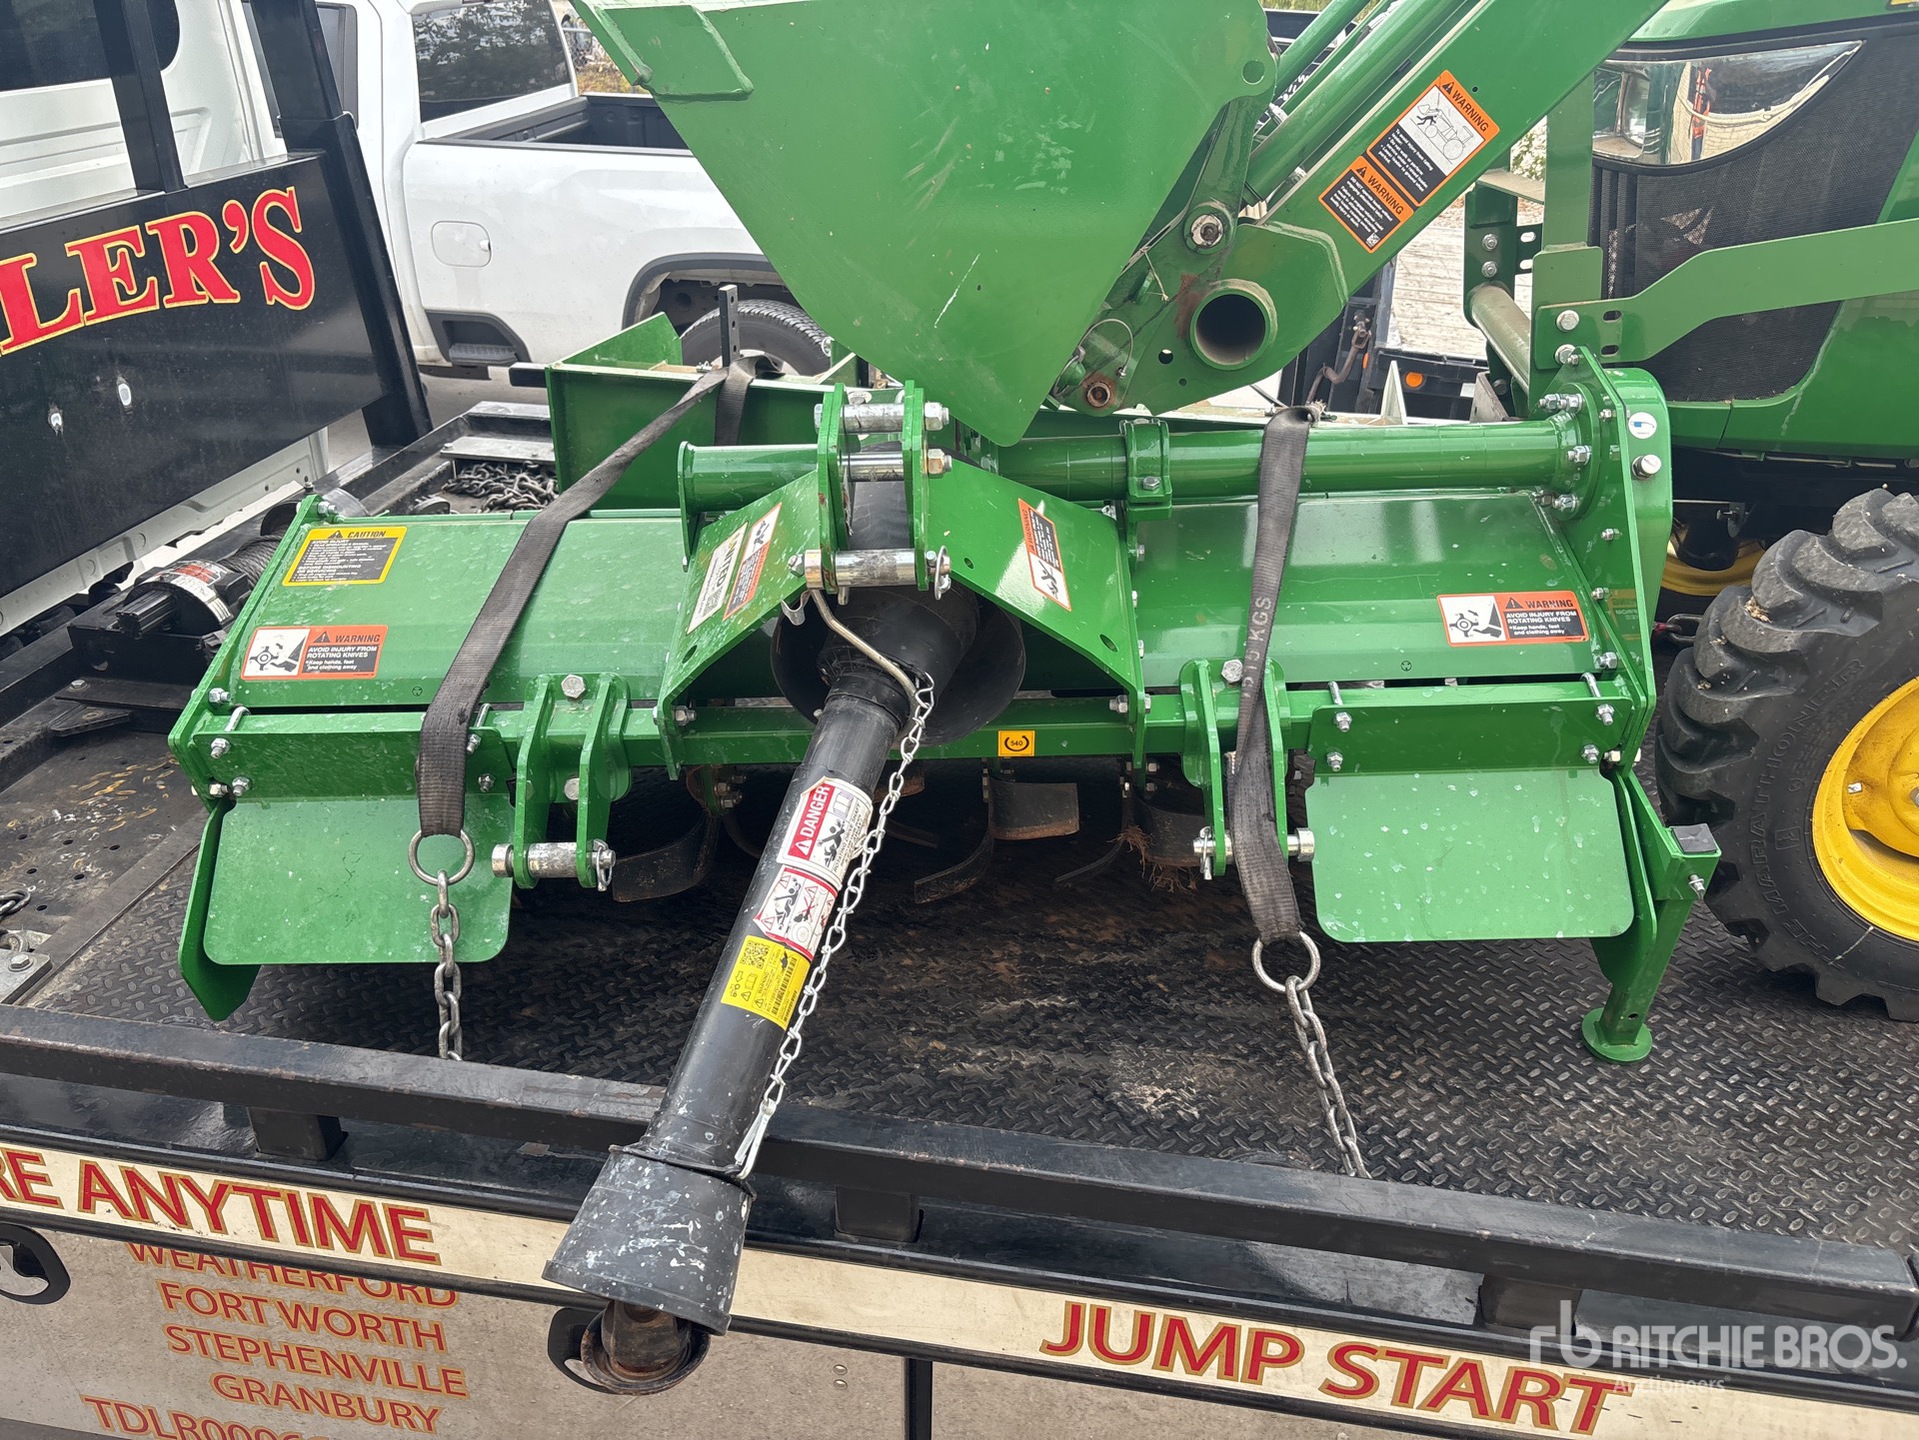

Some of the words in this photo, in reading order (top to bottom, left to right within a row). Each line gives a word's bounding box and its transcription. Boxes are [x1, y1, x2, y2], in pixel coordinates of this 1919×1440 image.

[1451, 90, 1489, 132] WARNING
[1366, 175, 1404, 214] WARNING
[347, 530, 386, 539] CAUTION
[1247, 596, 1272, 641] KGS
[1525, 599, 1574, 609] WARNING
[335, 634, 381, 643] WARNING
[800, 785, 831, 839] DANGER
[78, 1158, 441, 1266] ANYTIME
[125, 1242, 460, 1309] WEATHERFORD
[156, 1279, 268, 1327] FORT
[275, 1299, 448, 1352] WORTH
[162, 1322, 470, 1398] STEPHENVILLE
[1039, 1300, 1306, 1386] JUMP
[1317, 1340, 1632, 1435] START
[208, 1372, 444, 1434] GRANBURY
